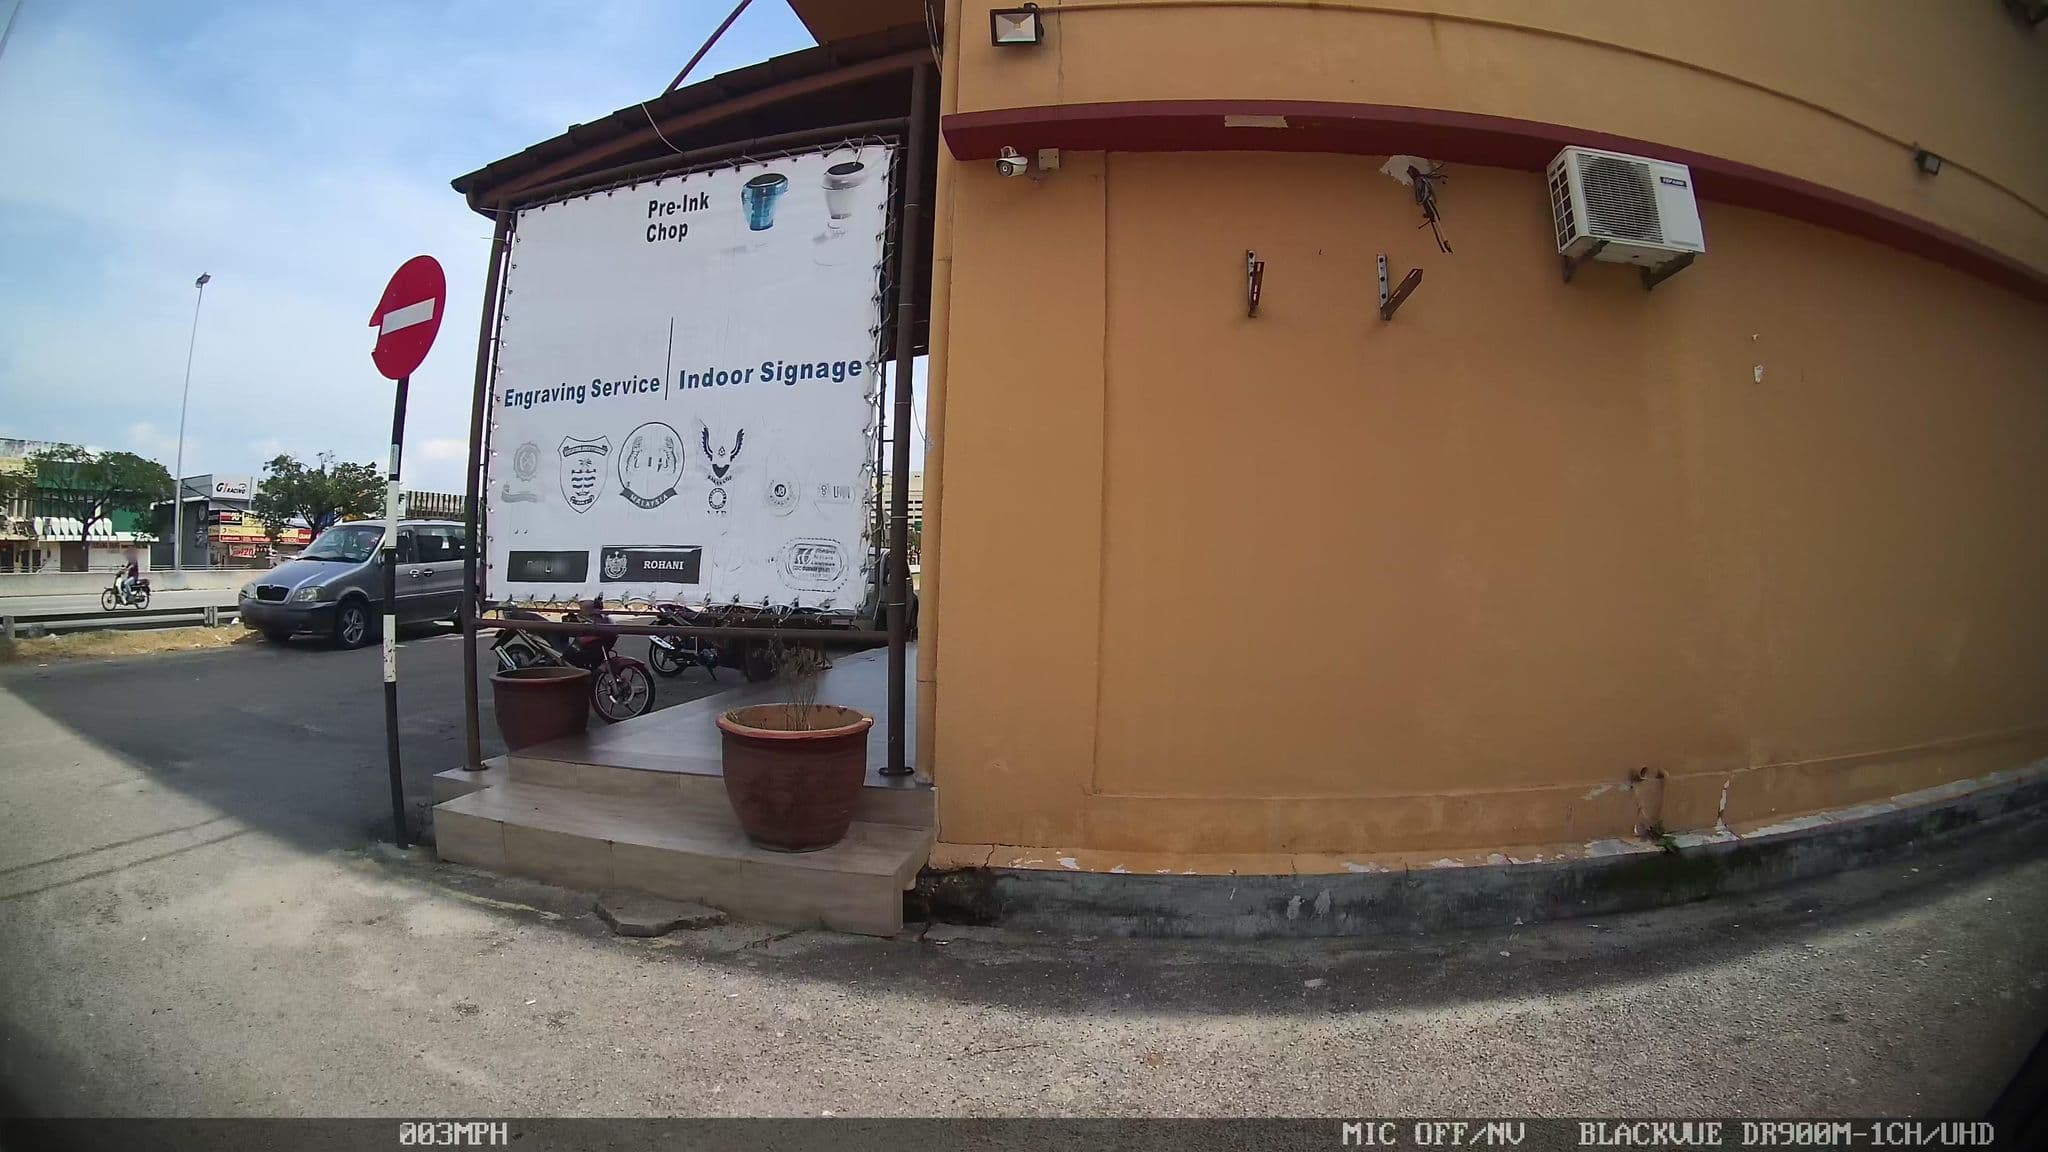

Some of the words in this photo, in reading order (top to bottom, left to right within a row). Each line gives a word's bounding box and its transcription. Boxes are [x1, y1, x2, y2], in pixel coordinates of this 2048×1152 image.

[648, 191, 709, 218] Pre-Ink
[646, 222, 688, 243] Chop
[679, 366, 754, 390] Indoor
[760, 359, 863, 385] Signage
[504, 382, 586, 409] Engraving
[590, 375, 660, 398] Service
[643, 560, 684, 570] ROHANI
